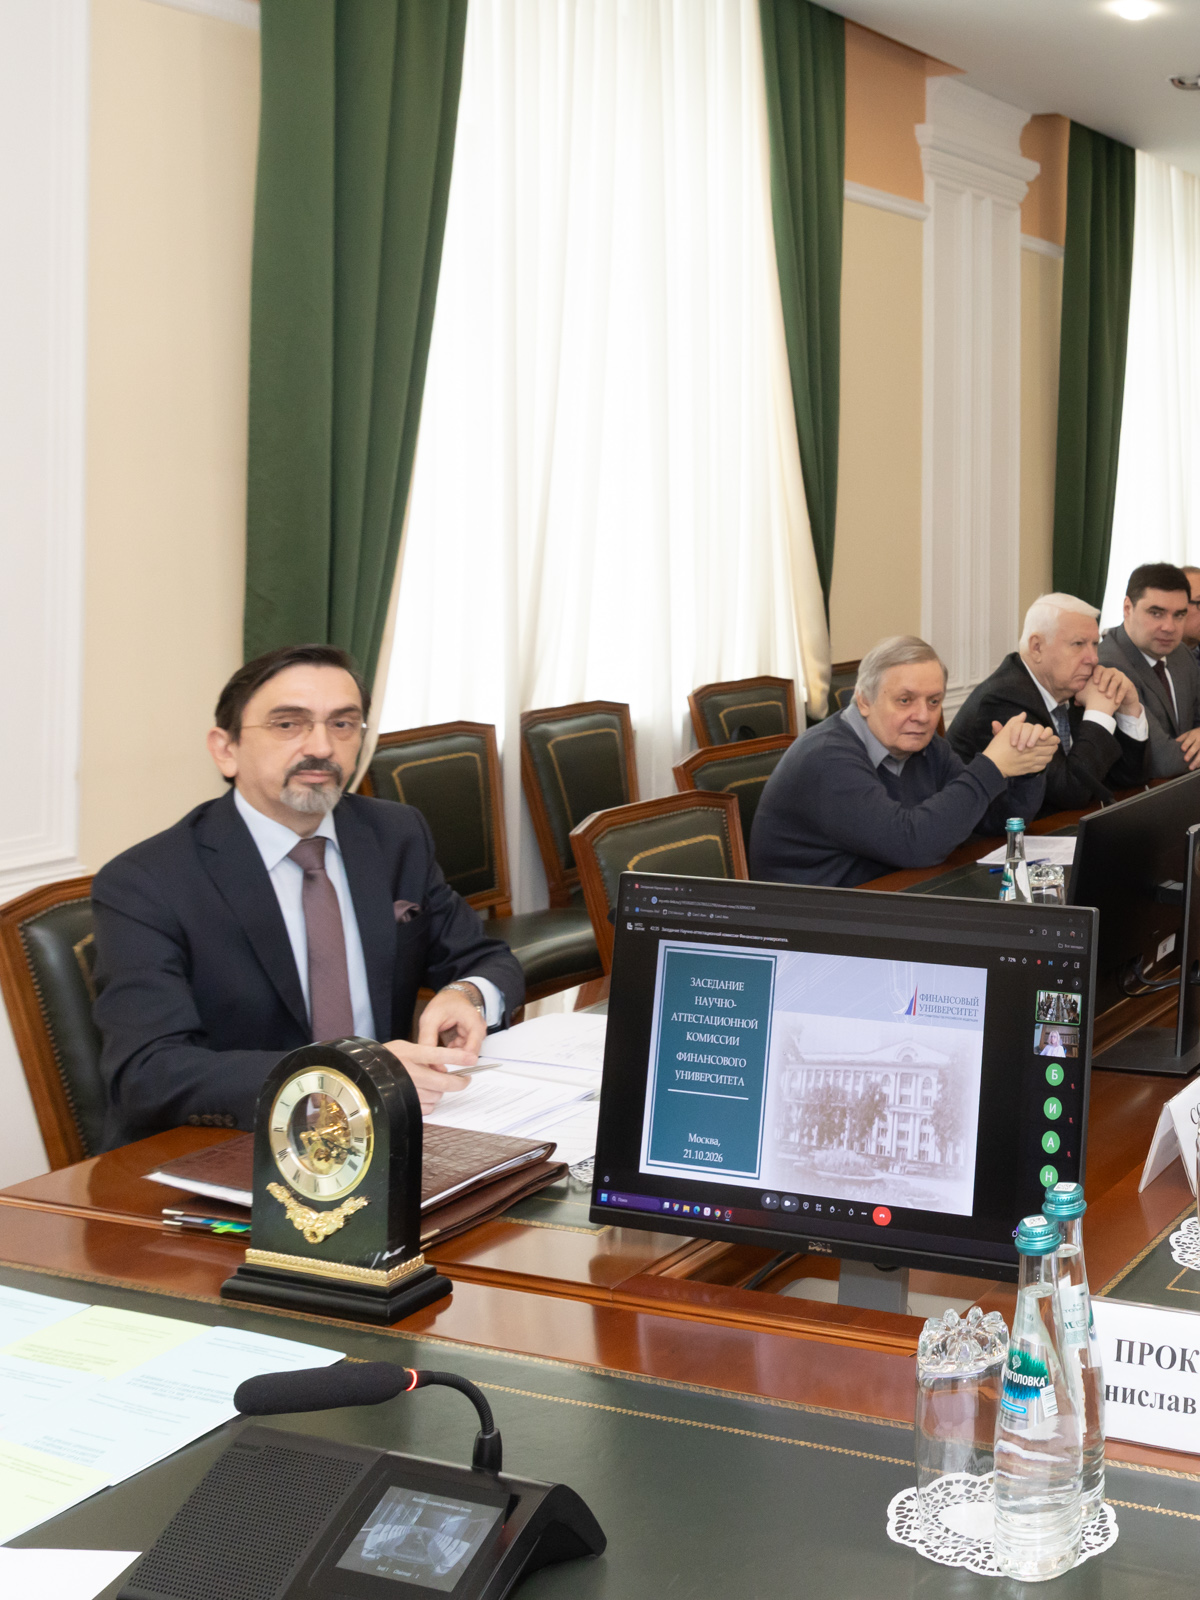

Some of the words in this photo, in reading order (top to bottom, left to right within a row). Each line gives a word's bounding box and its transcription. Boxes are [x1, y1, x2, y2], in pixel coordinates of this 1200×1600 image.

[690, 977, 744, 991] ЗАСЕДАНИЕ
[694, 996, 737, 1008] НАУЧНО-
[919, 994, 980, 1006] ФИНАНСОВЫЙ
[919, 1004, 980, 1017] УНИВЕРСИТЕТ
[671, 1012, 758, 1030] АТТЕСТАЦИОННОЙ
[686, 1032, 740, 1046] КОМИССИИ
[676, 1051, 746, 1068] ФИНАНСОВОГО
[674, 1070, 745, 1086] УНИВЕРСИТЕТА
[1052, 1069, 1058, 1080] Б
[1049, 1103, 1056, 1114] И
[688, 1132, 721, 1147] Москва,
[1047, 1137, 1054, 1148] А
[683, 1149, 723, 1162] 21.10.2026
[1045, 1171, 1052, 1182] Н
[1105, 1383, 1197, 1416] нислав
